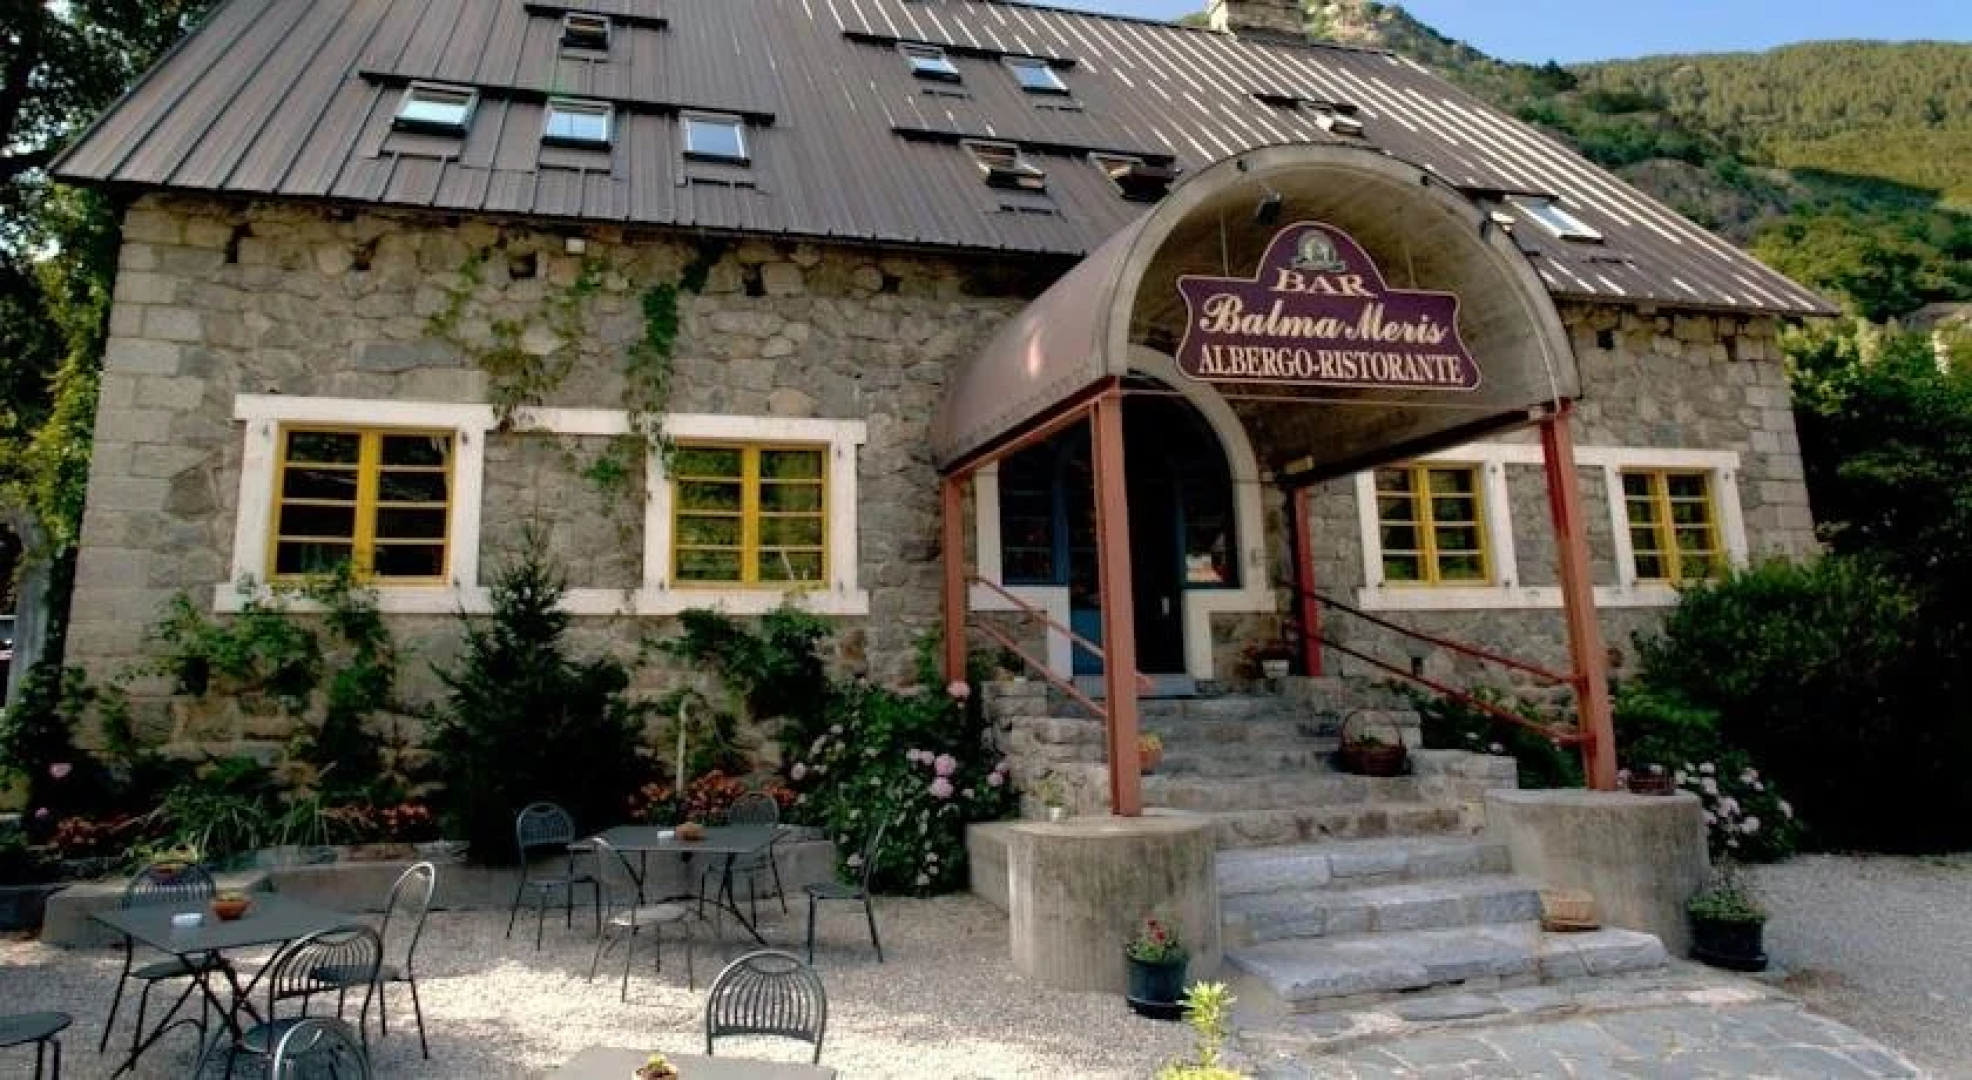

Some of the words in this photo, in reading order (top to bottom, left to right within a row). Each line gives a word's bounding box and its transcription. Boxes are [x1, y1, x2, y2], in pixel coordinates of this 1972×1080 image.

[1270, 268, 1378, 297] BAR
[1199, 293, 1346, 339] Balma
[1345, 302, 1448, 345] Meris
[1198, 345, 1465, 384] ALBERGO-RISTORANTE
